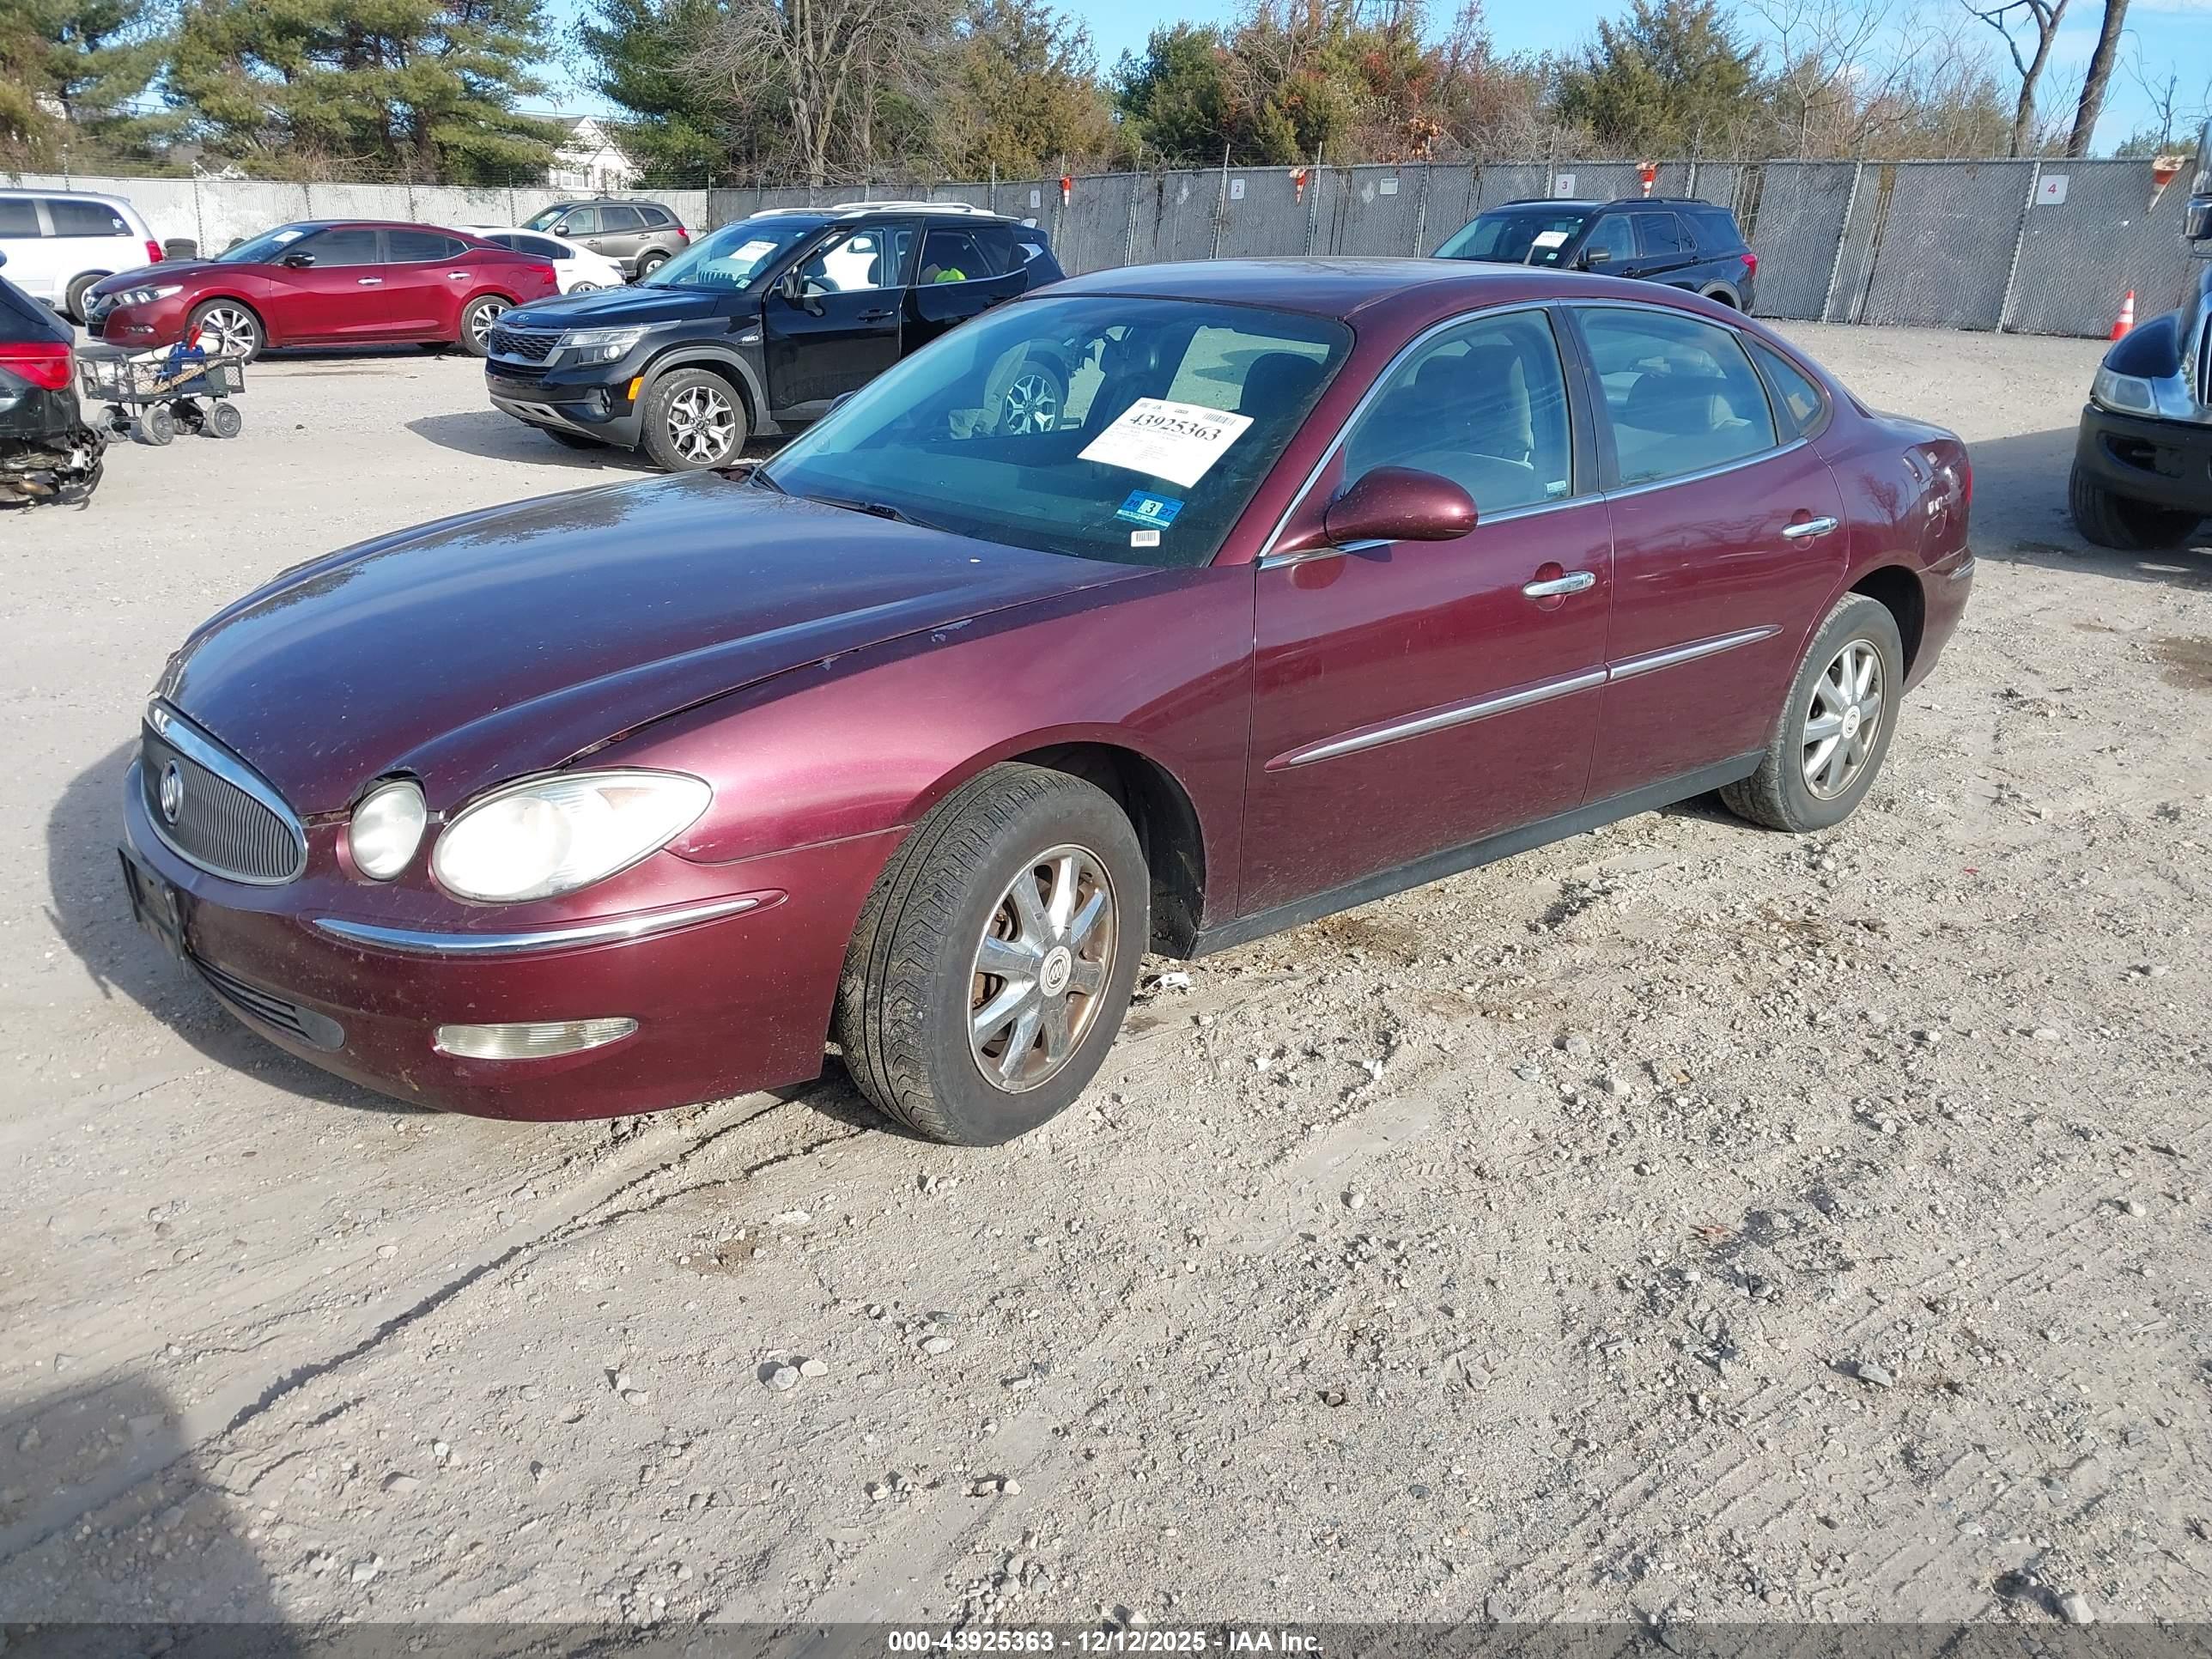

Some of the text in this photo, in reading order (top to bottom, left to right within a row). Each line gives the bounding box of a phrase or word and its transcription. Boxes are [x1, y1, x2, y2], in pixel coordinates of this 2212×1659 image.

[1236, 185, 1241, 193] 2
[1562, 180, 1568, 190] 3
[2047, 183, 2057, 194] 4
[1130, 413, 1222, 441] 43925363
[1127, 499, 1140, 508] 20
[1146, 502, 1157, 514] 3
[1160, 507, 1176, 517] 27
